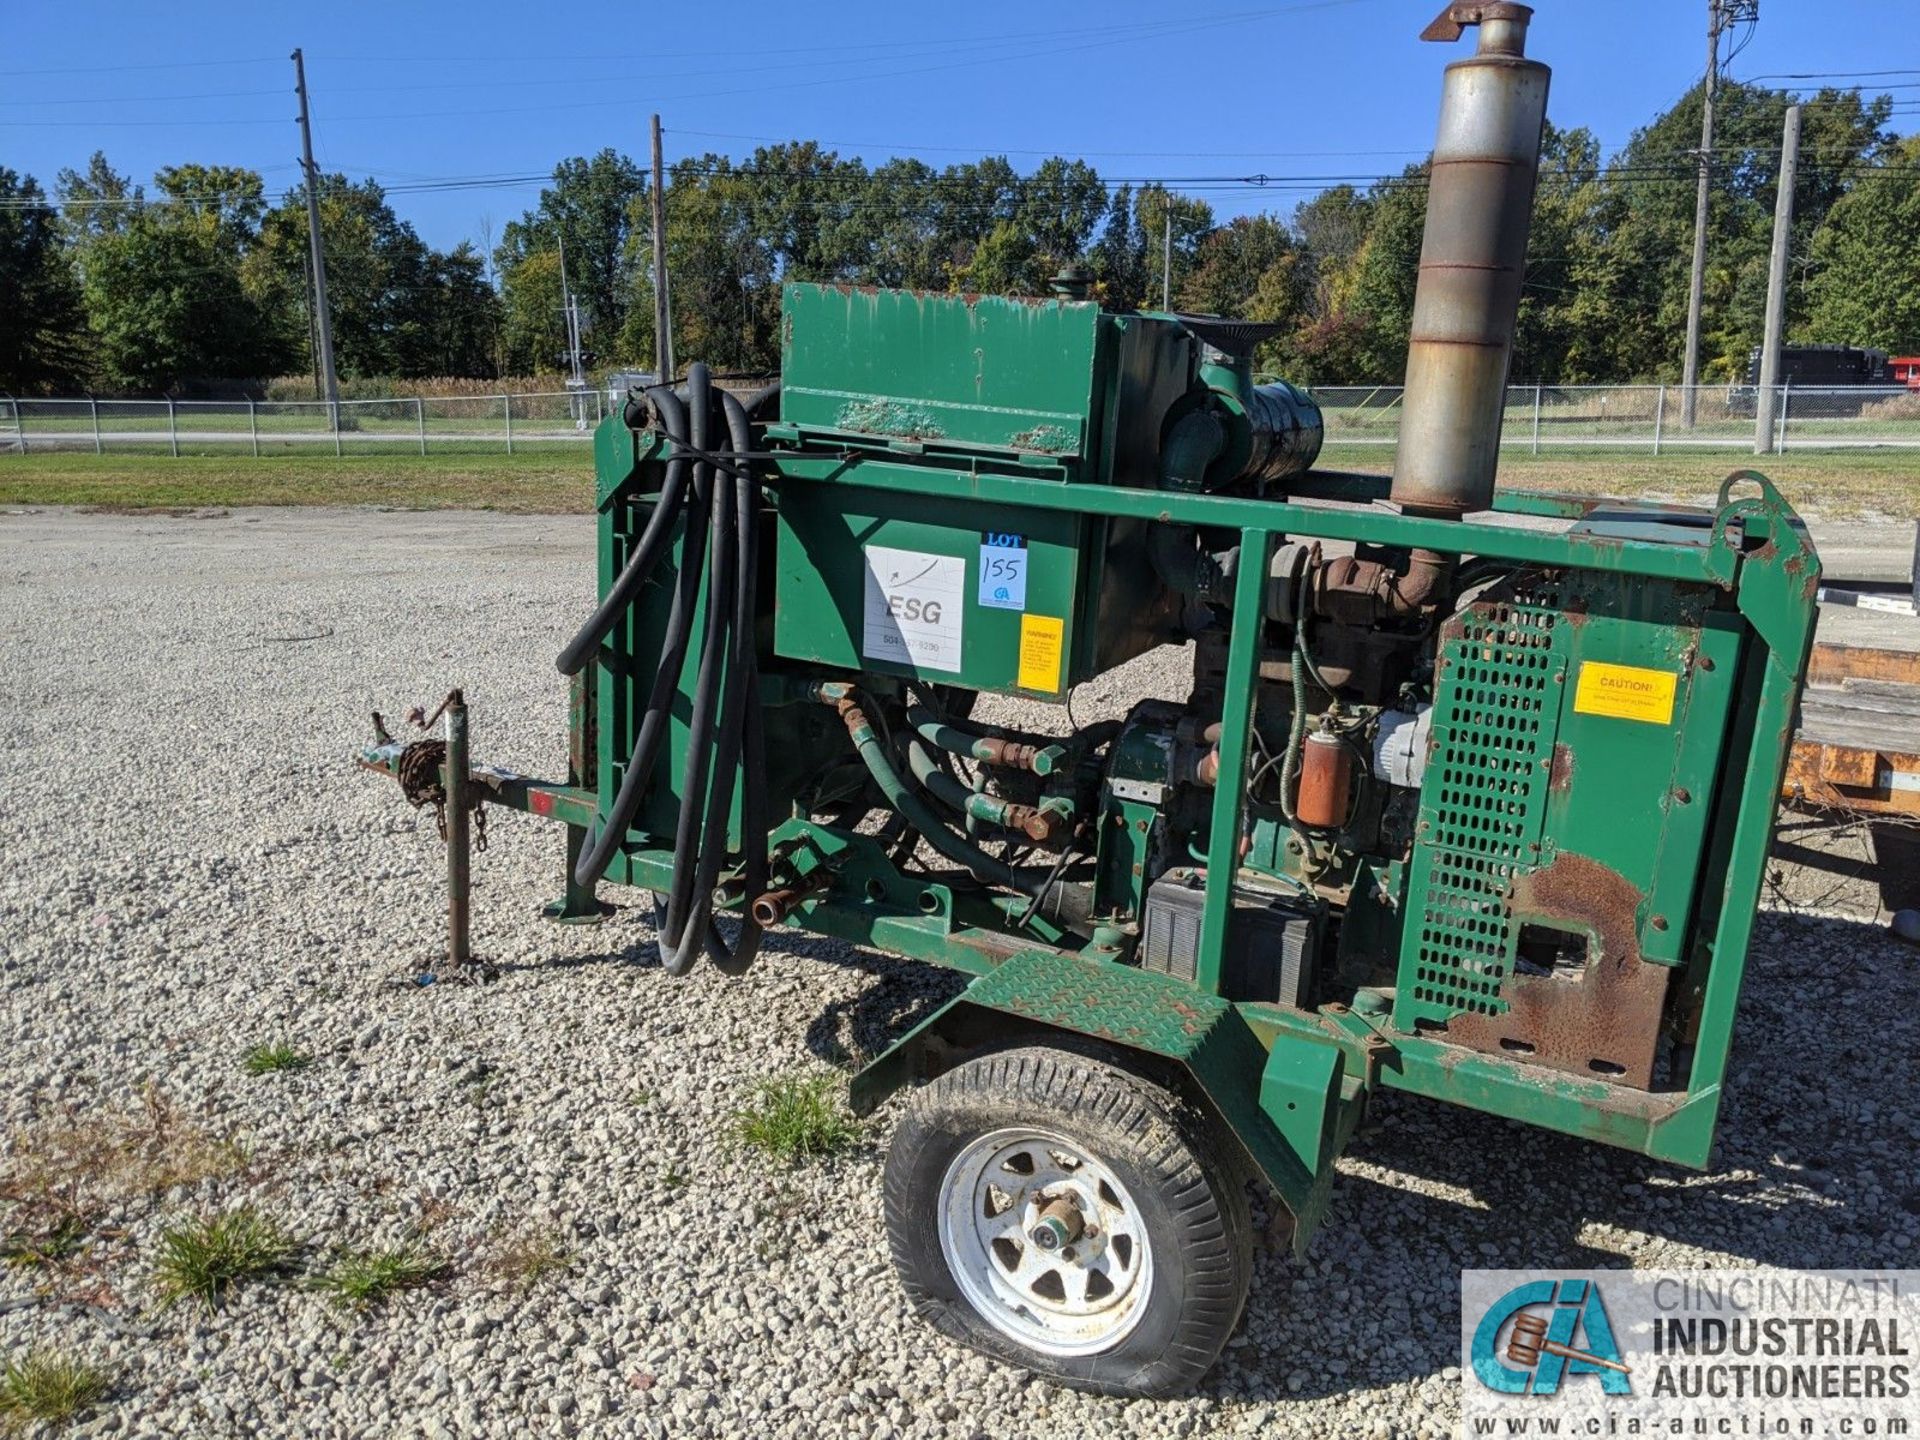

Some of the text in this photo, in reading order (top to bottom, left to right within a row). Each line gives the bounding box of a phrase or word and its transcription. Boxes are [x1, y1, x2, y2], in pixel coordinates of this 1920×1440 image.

[987, 532, 1023, 549] LOT
[982, 557, 1022, 583] 155
[886, 594, 942, 625] ESG
[1600, 677, 1653, 692] CAUTION!
